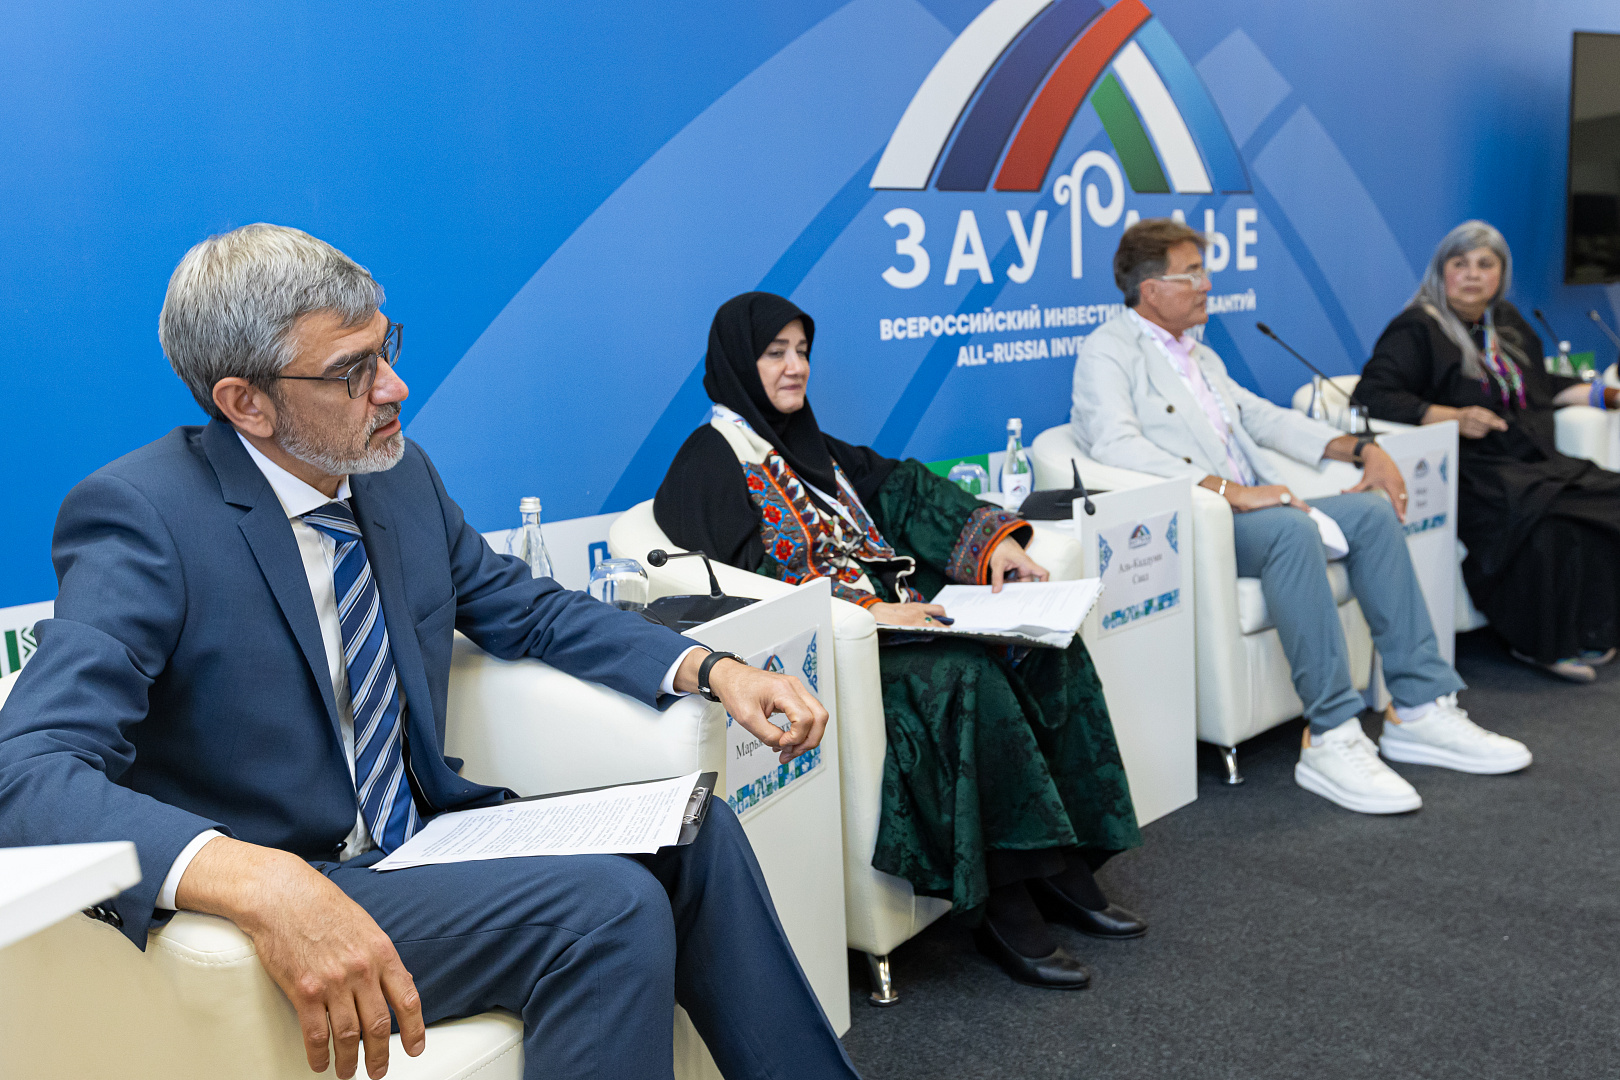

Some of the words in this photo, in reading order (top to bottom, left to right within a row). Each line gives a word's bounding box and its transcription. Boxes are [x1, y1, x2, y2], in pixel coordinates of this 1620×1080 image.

[881, 150, 1258, 289] ЗАУРЬЕ
[880, 304, 1041, 340] ВСЕРОССИЙСКИЙ
[957, 338, 1049, 367] ALL-RUSSIA
